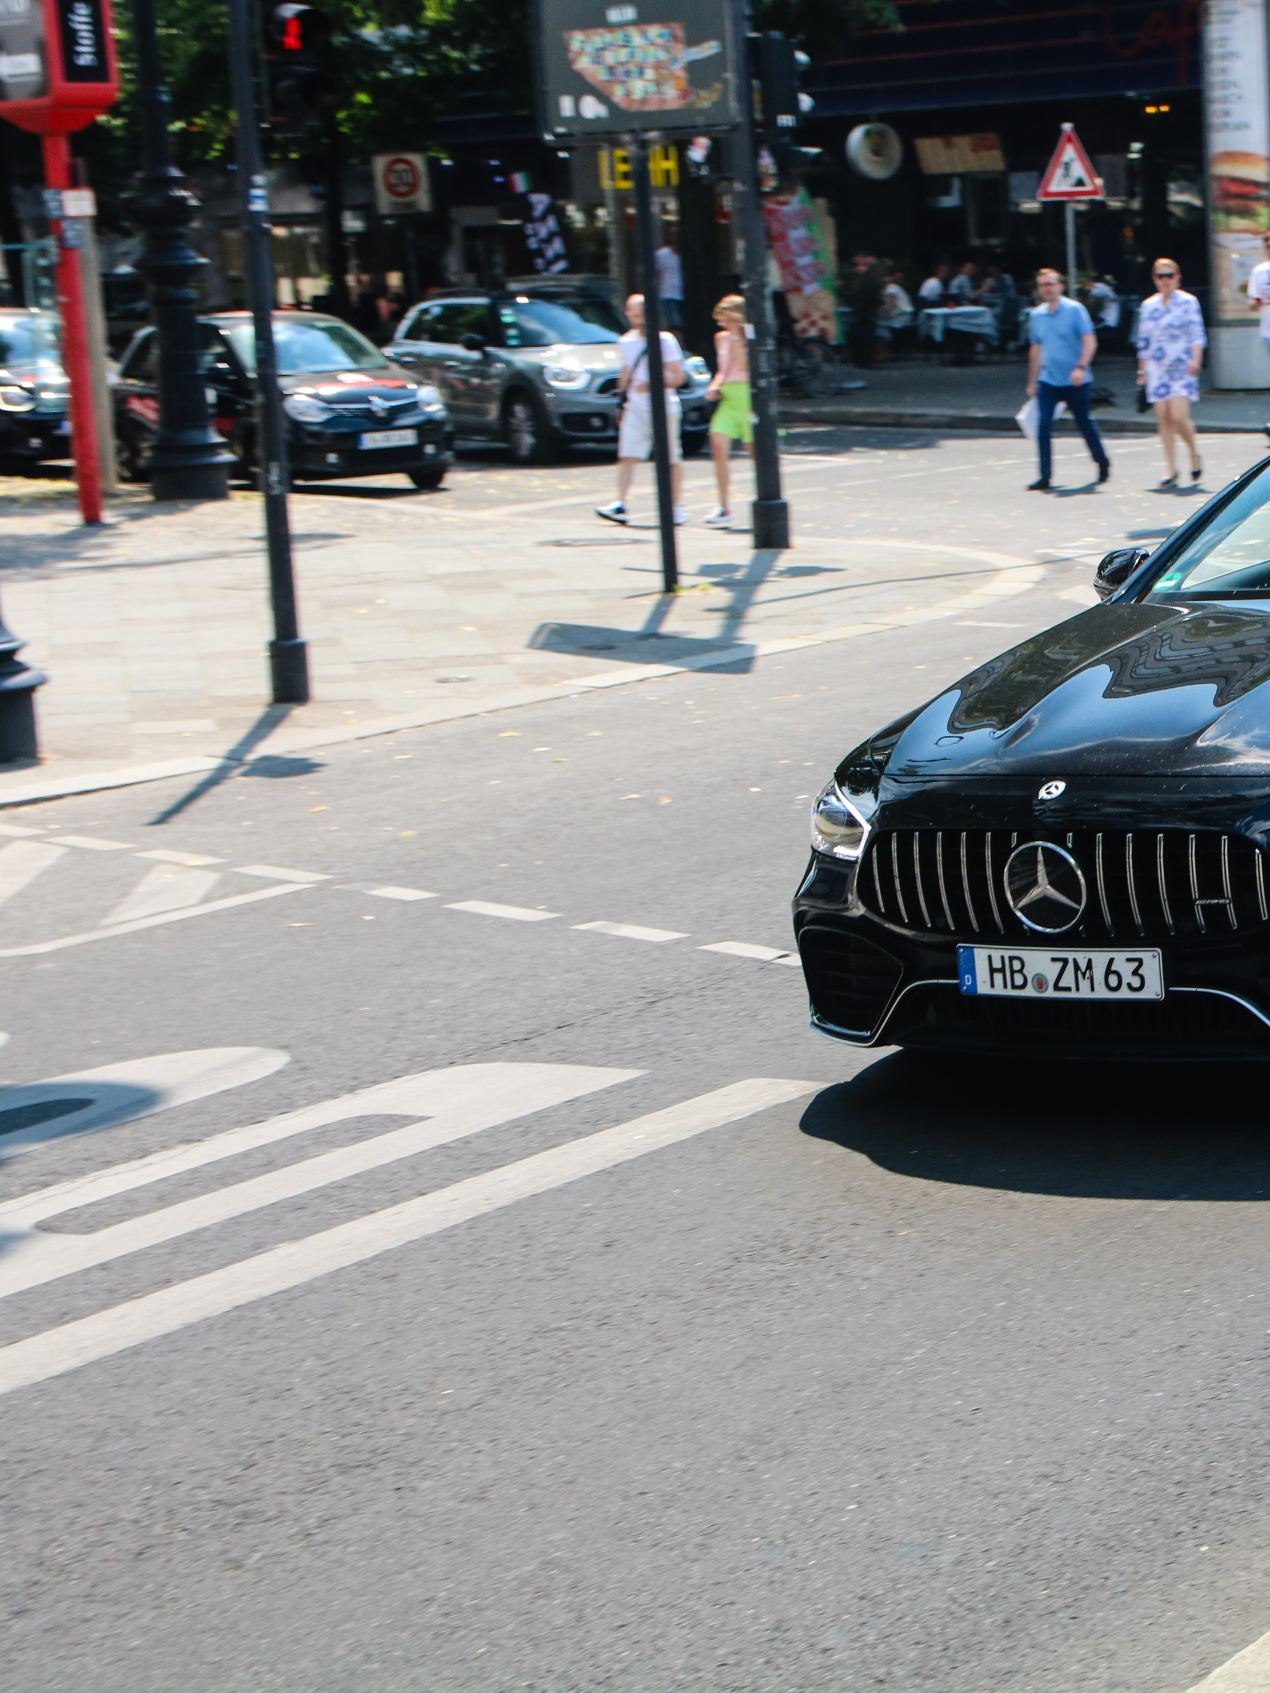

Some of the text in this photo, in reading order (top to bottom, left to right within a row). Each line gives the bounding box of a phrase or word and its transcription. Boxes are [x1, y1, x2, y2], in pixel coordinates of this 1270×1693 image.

[67, 1, 98, 66] Stoffe
[964, 974, 972, 986] D
[987, 955, 1145, 992] HB ZM 63
